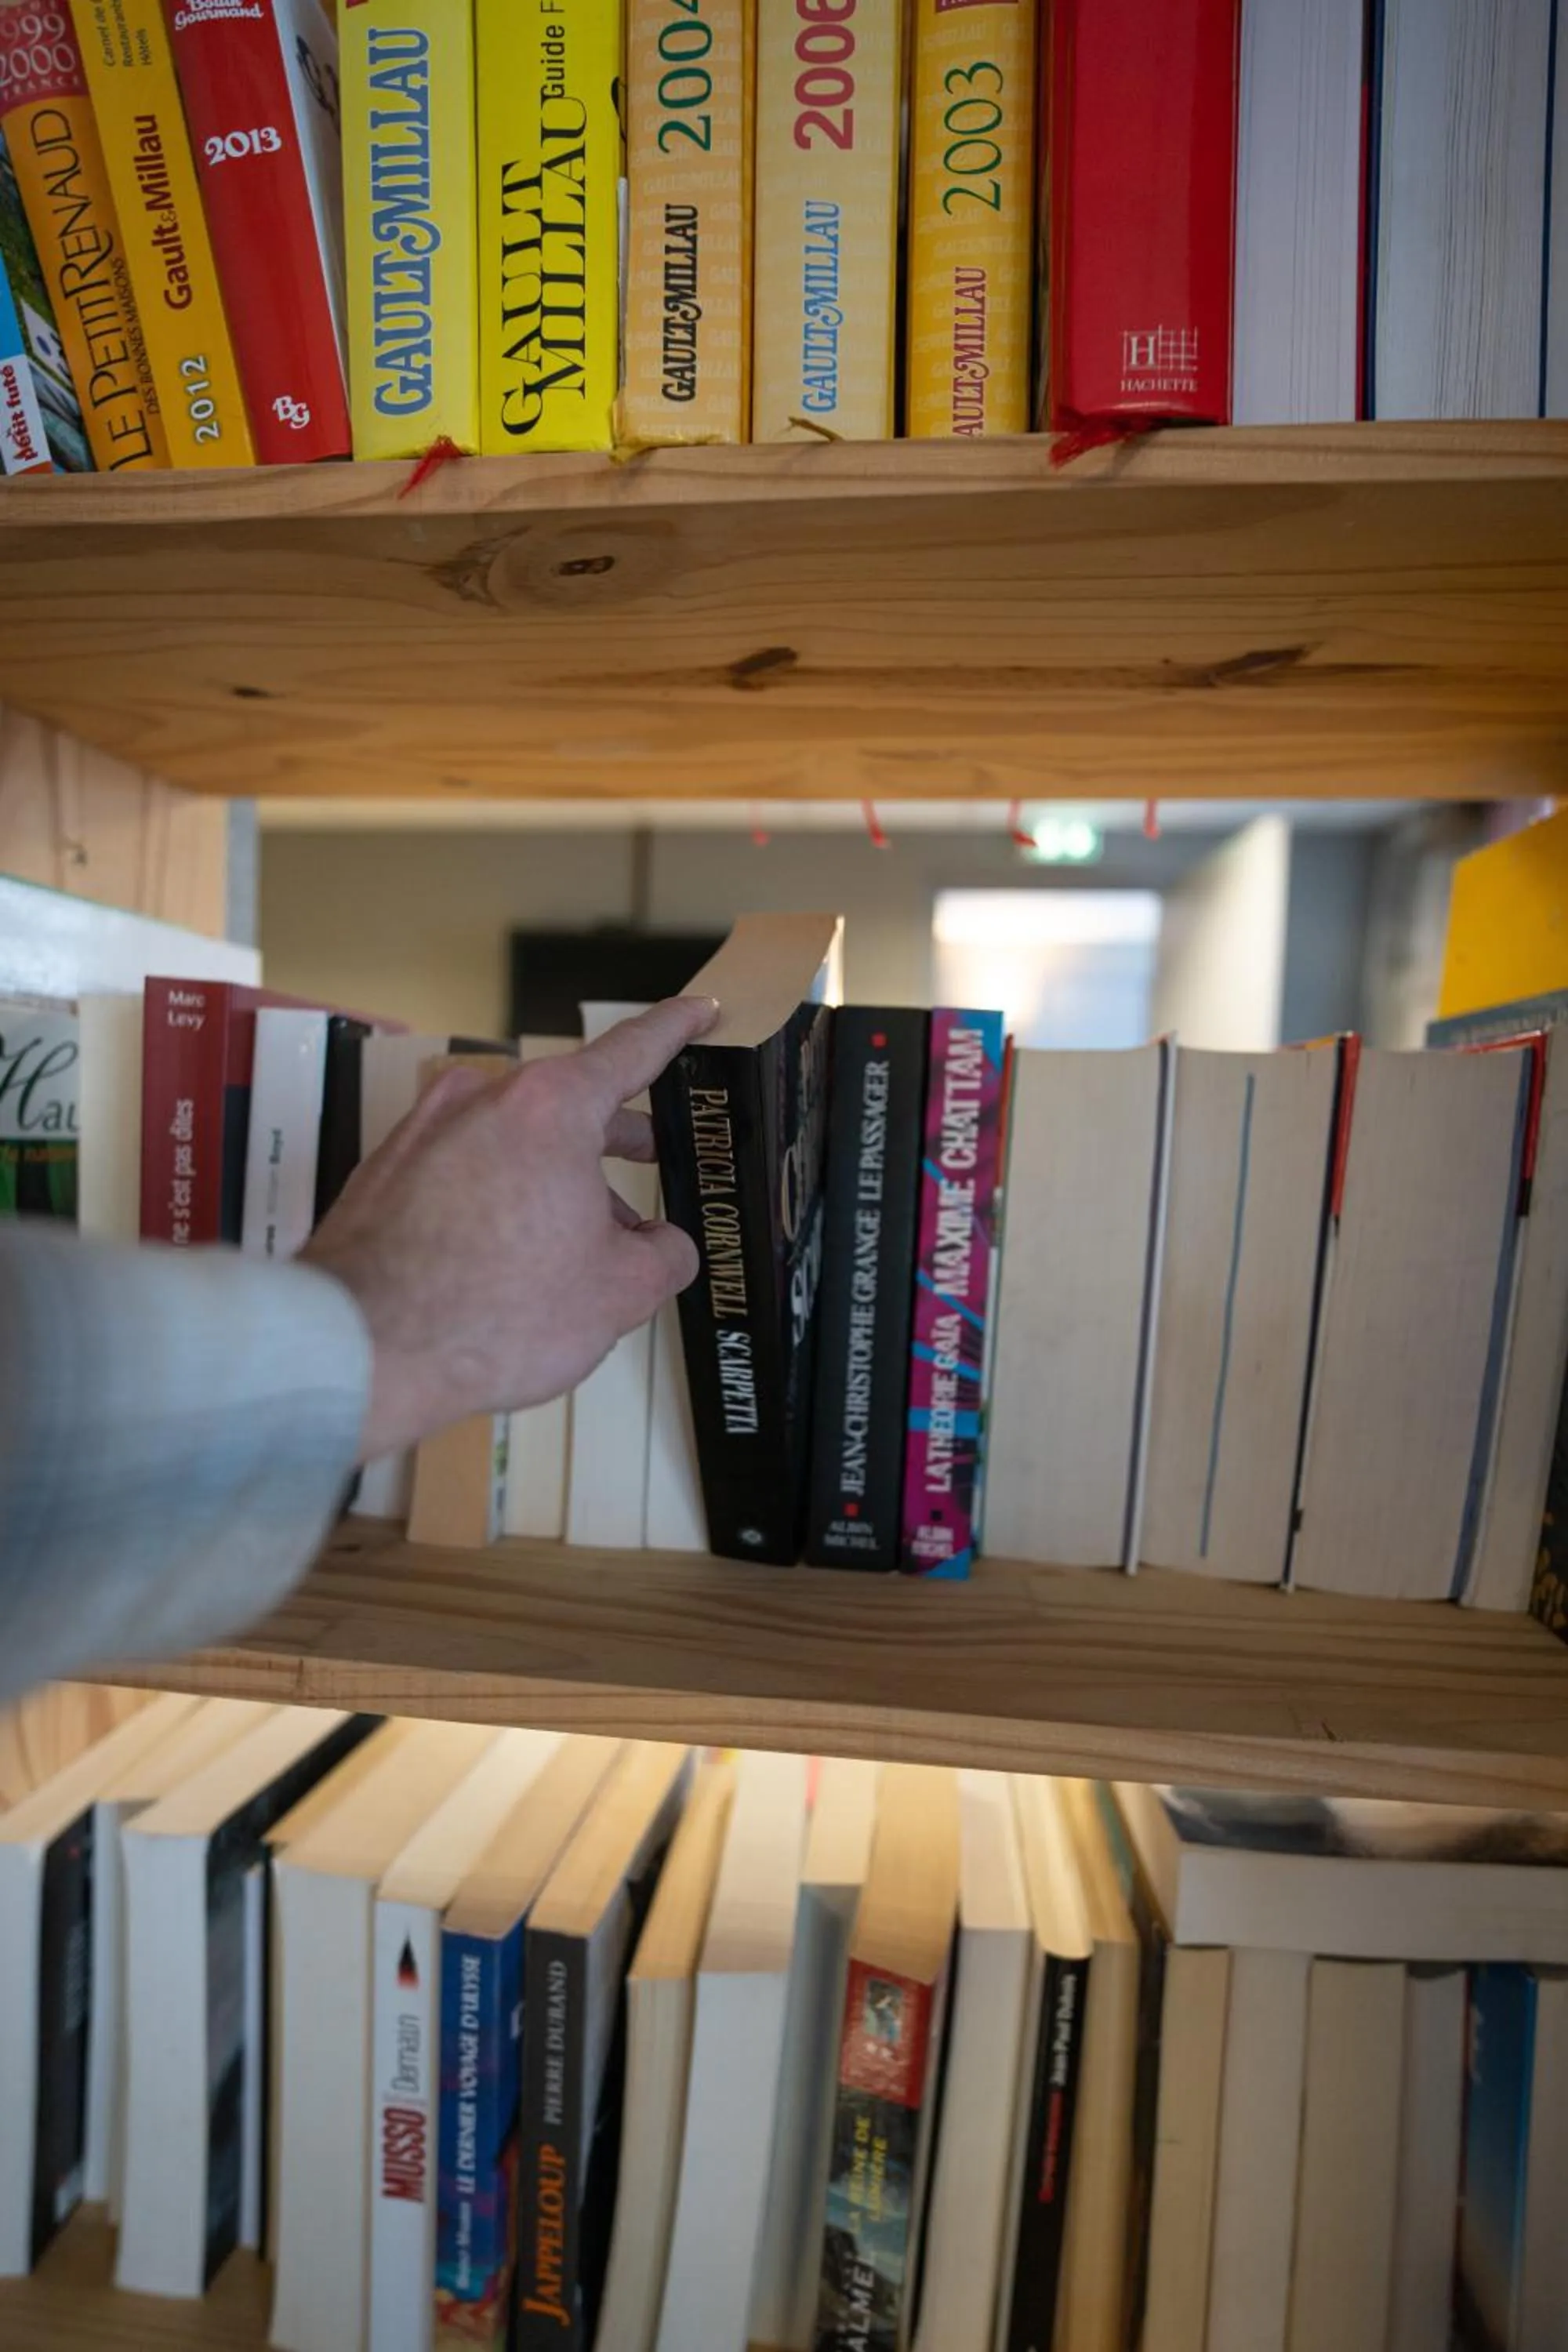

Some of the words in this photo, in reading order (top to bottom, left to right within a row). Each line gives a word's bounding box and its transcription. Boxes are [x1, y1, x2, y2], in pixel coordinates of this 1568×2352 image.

[94, 6, 104, 24] de
[96, 26, 116, 67] Carnet
[175, 4, 264, 31] Gourmand
[541, 24, 565, 99] Guide
[793, 0, 855, 151] 2006
[204, 126, 283, 167] 2013
[942, 61, 1004, 216] 2003
[540, 96, 587, 400] MILLAU
[111, 256, 139, 324] MAISONS
[501, 159, 543, 436] GAULT
[128, 327, 154, 384] BONNES
[1120, 378, 1199, 393] HACHETTE
[143, 387, 160, 416] DES
[180, 354, 220, 445] 2012
[6, 411, 38, 461] petit
[110, 409, 154, 470] LE
[167, 1011, 205, 1030] Levy
[168, 989, 205, 1009] Marc
[859, 1060, 890, 1169] PASSAGER
[940, 1026, 985, 1169] CHATTAM
[173, 1144, 198, 1177] pas
[688, 1086, 732, 1198] PATRICIA
[858, 1171, 883, 1201] LE
[700, 1200, 749, 1321] CORNWELL
[933, 1178, 977, 1297] MAXIME
[716, 1329, 759, 1435] SCARPETTA
[840, 1305, 876, 1497] JEAN-CHRISTOPHE
[543, 1959, 568, 2053] DURAND
[458, 2032, 481, 2099] VOYAGE
[543, 2056, 565, 2125] PIERRE
[381, 2107, 426, 2204] MUSSO
[854, 2114, 871, 2143] DE
[521, 2143, 572, 2327] JAPPELOUP
[848, 2249, 876, 2352] ALMEL
